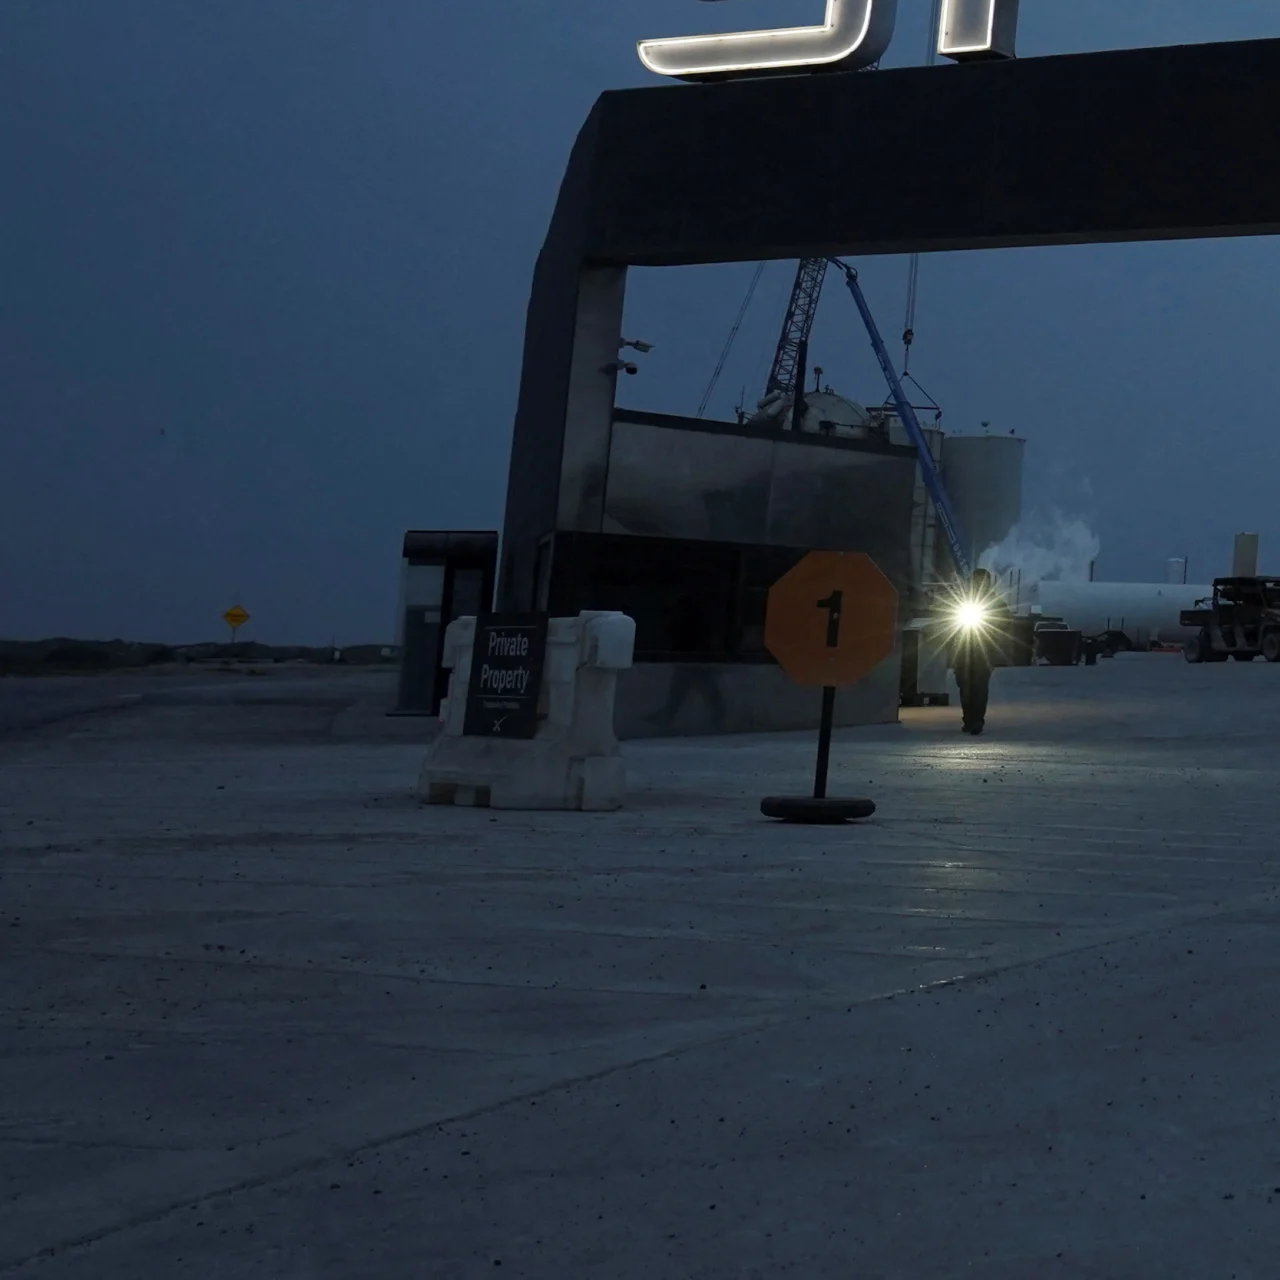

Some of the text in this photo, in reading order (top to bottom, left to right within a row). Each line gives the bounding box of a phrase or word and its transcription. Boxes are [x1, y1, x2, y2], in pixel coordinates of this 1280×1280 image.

[816, 590, 842, 647] 1
[488, 631, 529, 656] Private
[480, 663, 530, 694] Property
